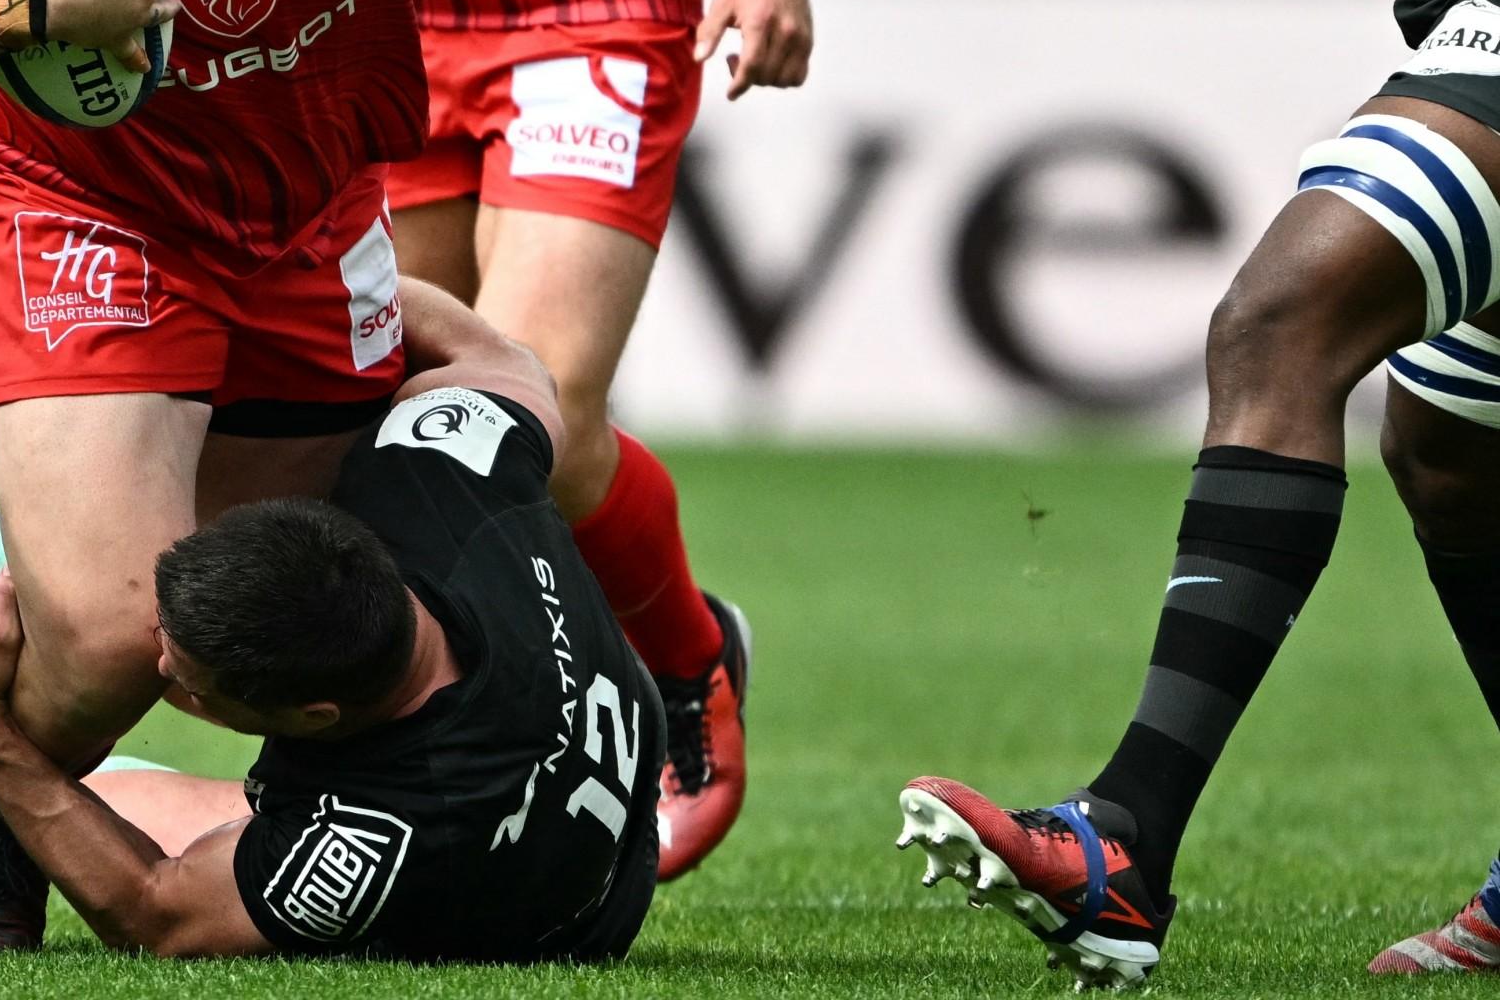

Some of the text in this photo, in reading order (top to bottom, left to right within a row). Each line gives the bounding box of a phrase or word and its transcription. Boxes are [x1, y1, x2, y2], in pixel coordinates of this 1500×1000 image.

[518, 124, 629, 155] SOLVEO
[41, 231, 117, 304] HG
[28, 293, 87, 310] CONSEIL
[30, 306, 145, 326] DÉPARTEMENTAL
[530, 556, 577, 774] NATIXIS
[566, 673, 640, 843] 12
